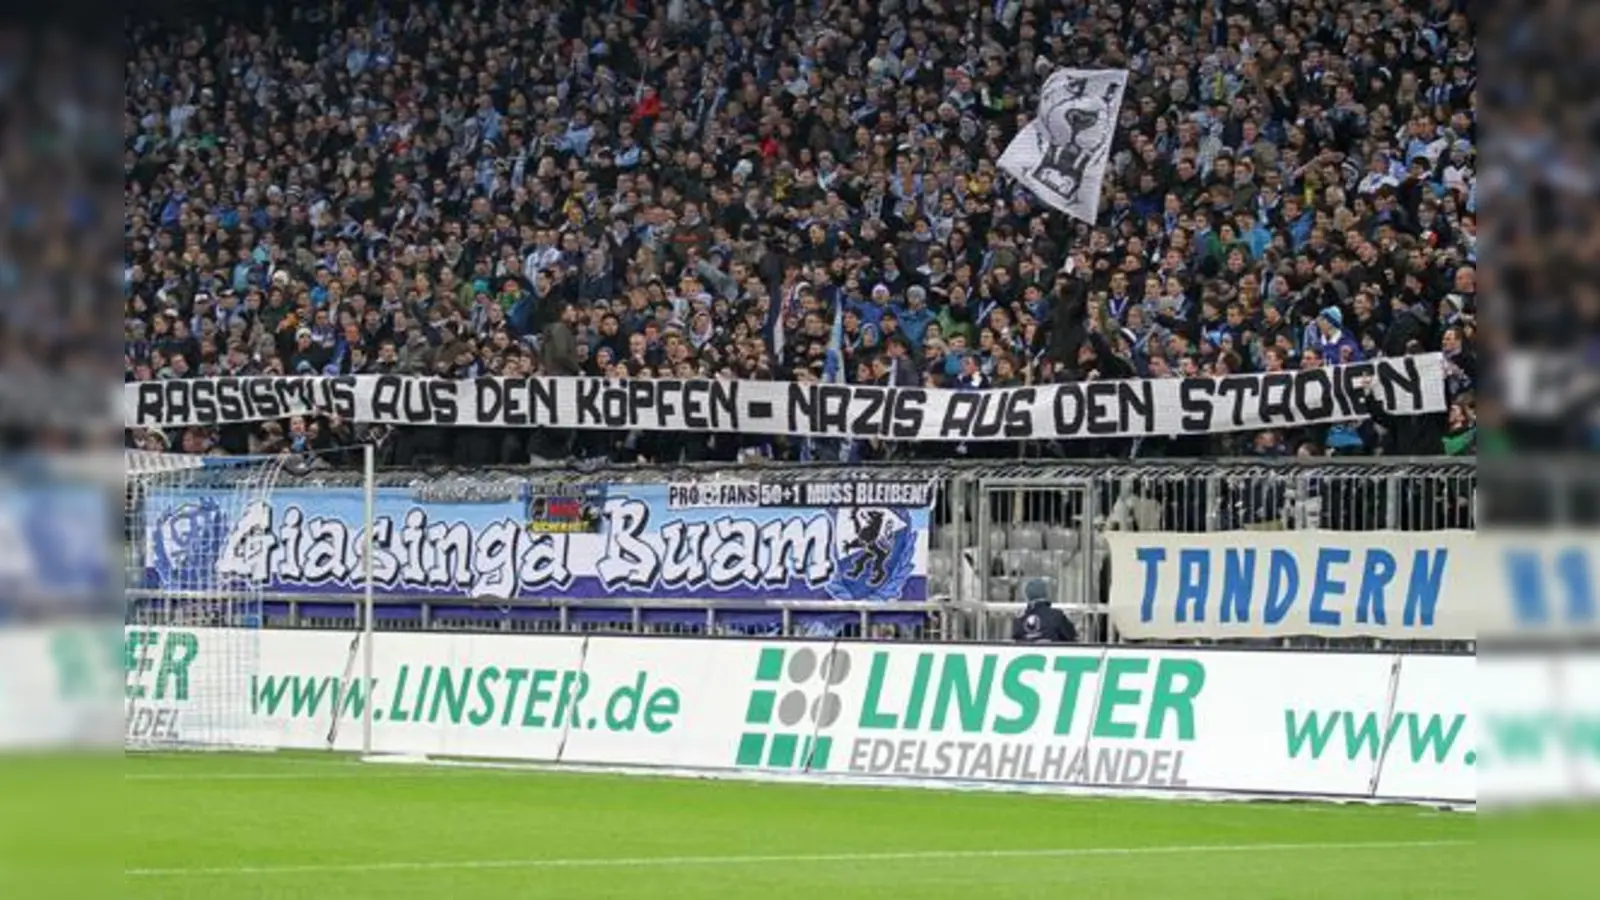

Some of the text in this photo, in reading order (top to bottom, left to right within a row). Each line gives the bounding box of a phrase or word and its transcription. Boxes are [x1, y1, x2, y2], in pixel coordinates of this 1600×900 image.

[137, 376, 355, 424] RASSISMUS
[372, 375, 458, 423] AUS
[475, 376, 558, 425] DEN
[576, 379, 738, 429] KÖPFEN
[788, 382, 926, 437] NAZIS
[940, 387, 1036, 438] AUS
[669, 485, 757, 505] PRO FANS
[806, 483, 852, 504] MUSS
[219, 495, 836, 598] Giasinga Buam
[1138, 548, 1447, 625] TANDERN
[251, 665, 679, 732] www.LINSTER.de
[858, 652, 1206, 741] LINSTER
[850, 739, 1188, 785] EDELSTAHLHANDEL
